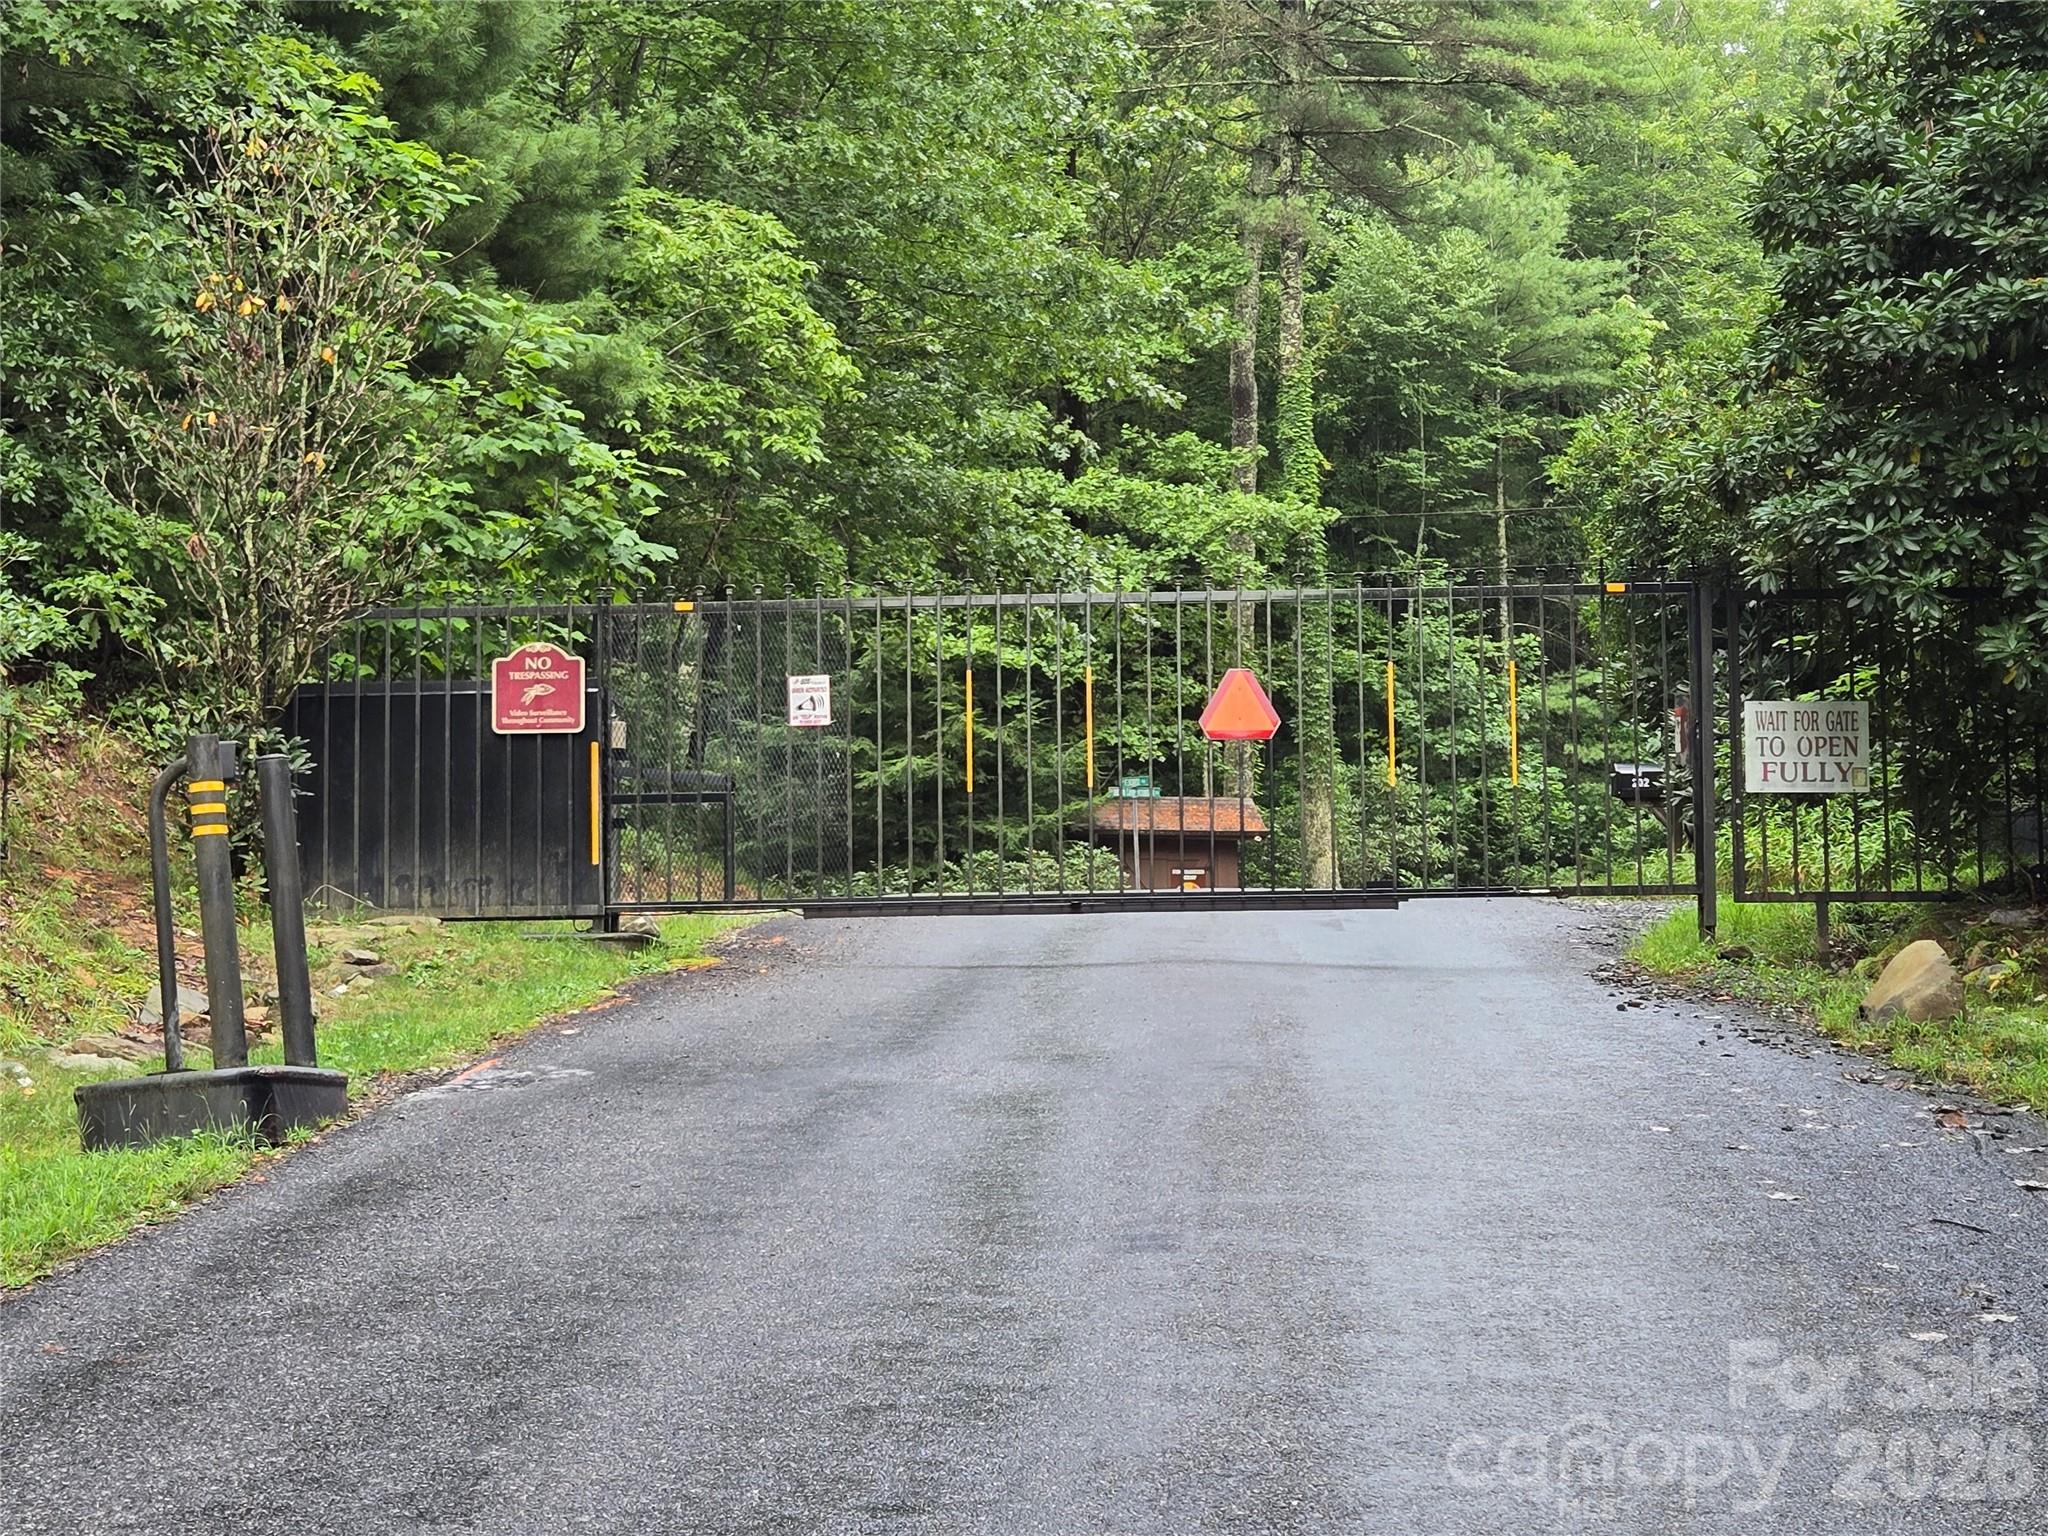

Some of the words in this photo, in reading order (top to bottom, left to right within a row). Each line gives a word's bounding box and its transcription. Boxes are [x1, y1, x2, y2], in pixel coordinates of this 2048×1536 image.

[525, 656, 552, 670] NO
[508, 671, 570, 680] TRESPASSING
[1755, 710, 1788, 732] WAIT
[1794, 710, 1820, 732] FOR
[1826, 710, 1860, 732] GATE
[1755, 736, 1785, 757] TO
[1797, 736, 1859, 757] OPEN
[1762, 761, 1854, 783] FULLY
[1631, 777, 1650, 788] 202
